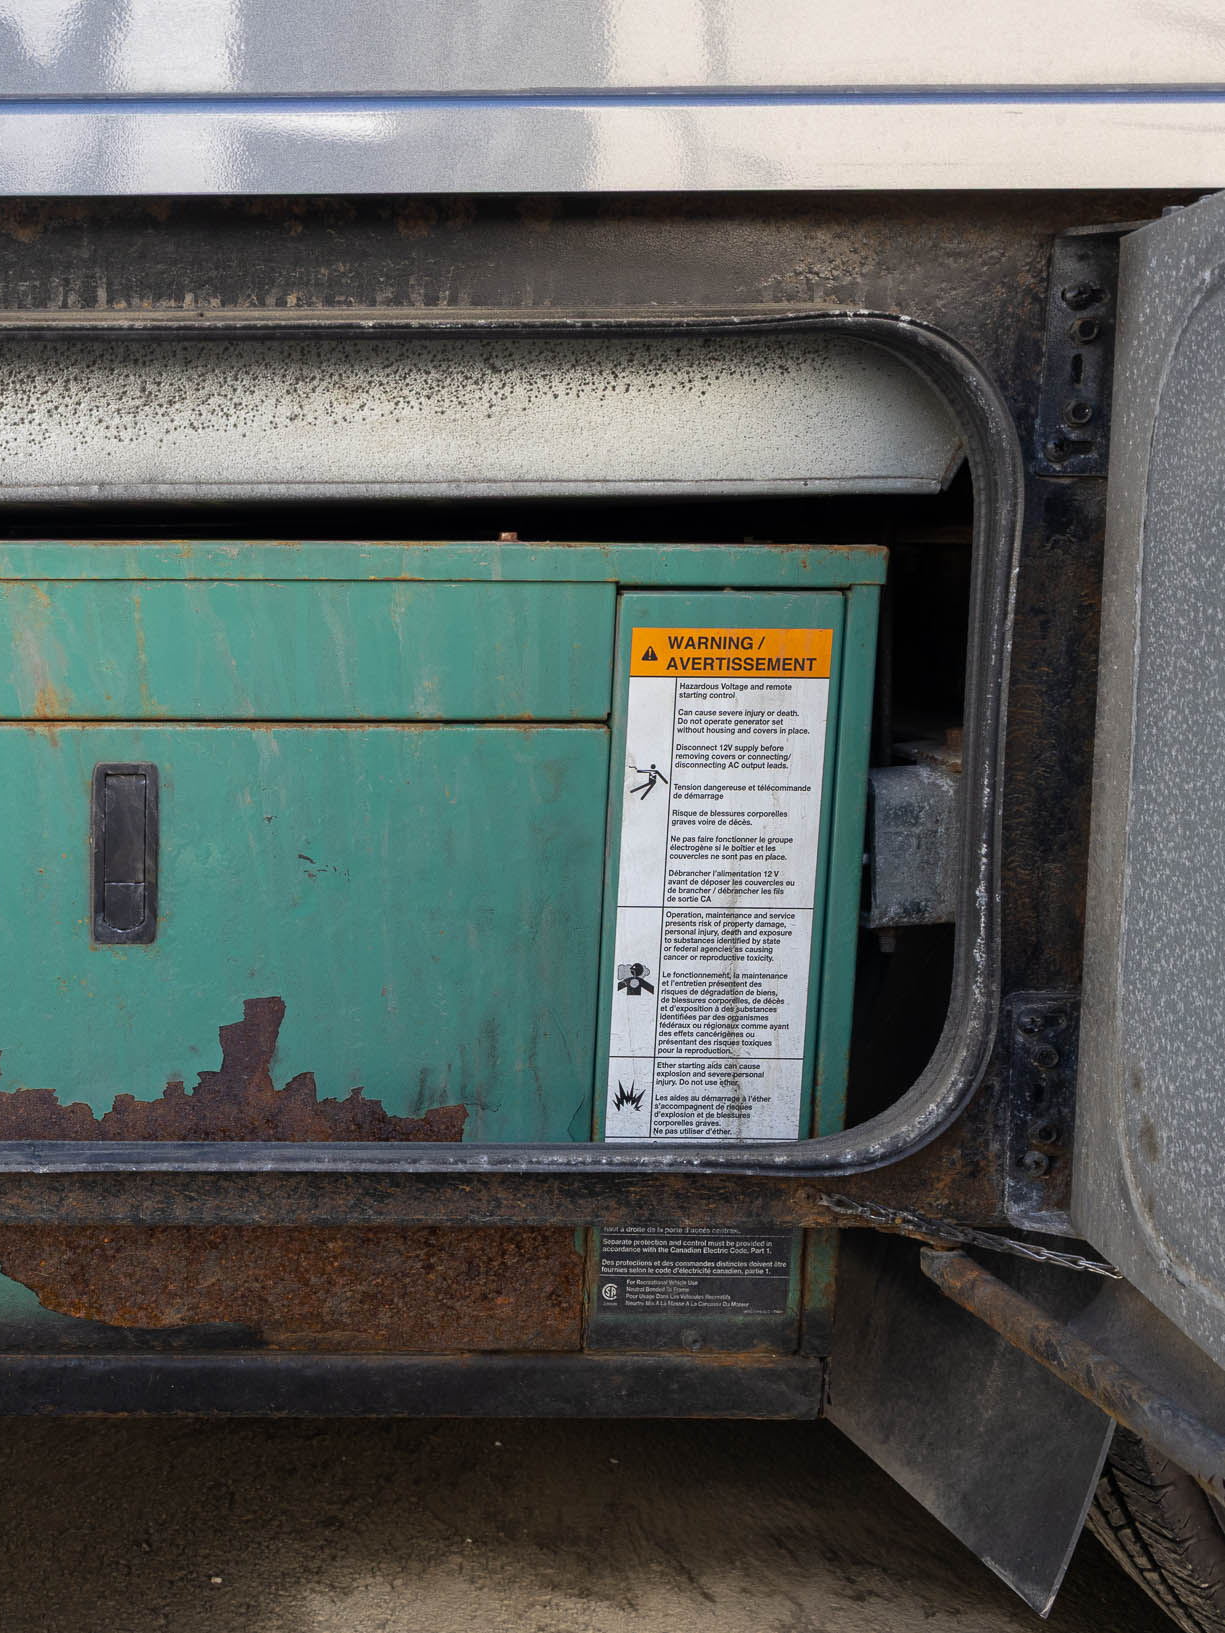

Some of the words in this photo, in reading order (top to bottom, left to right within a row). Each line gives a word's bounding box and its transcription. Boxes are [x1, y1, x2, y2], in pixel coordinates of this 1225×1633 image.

[667, 636, 754, 650] WARNING
[758, 636, 766, 650] /
[665, 657, 817, 672] AVERTISSEMENT
[720, 682, 748, 691] Voltage
[749, 682, 764, 690] and
[678, 691, 707, 700] starting
[744, 709, 765, 717] injury
[703, 718, 732, 726] operate
[733, 718, 770, 727] generator
[705, 726, 736, 735] housing
[787, 727, 810, 736] place.
[733, 743, 758, 752] supply
[674, 752, 710, 761] removing
[747, 753, 791, 762] connecting/
[674, 761, 726, 770] disconnecting
[740, 762, 765, 770] output
[702, 783, 747, 792] dangereuse
[683, 792, 724, 801] démarrage
[671, 809, 698, 818] Risque
[747, 809, 788, 818] corporelles
[671, 819, 696, 827] graves
[669, 843, 713, 852] électrogène
[765, 853, 788, 862] place.
[699, 878, 730, 887] déposer
[744, 878, 784, 886] couvercles
[773, 887, 784, 895] fils
[665, 910, 703, 919] Operation,
[753, 911, 767, 919] and
[664, 920, 697, 928] presents
[722, 920, 753, 929] property
[754, 920, 787, 929] damage,
[664, 928, 696, 936] personal
[697, 928, 719, 937] injury,
[751, 937, 761, 946] by
[699, 945, 732, 954] agencies
[744, 945, 773, 954] causing
[698, 953, 745, 962] reproductive
[746, 954, 774, 963] toxicity.
[677, 1061, 705, 1070] starting
[655, 1070, 690, 1079] explosion
[732, 1070, 764, 1079] personal
